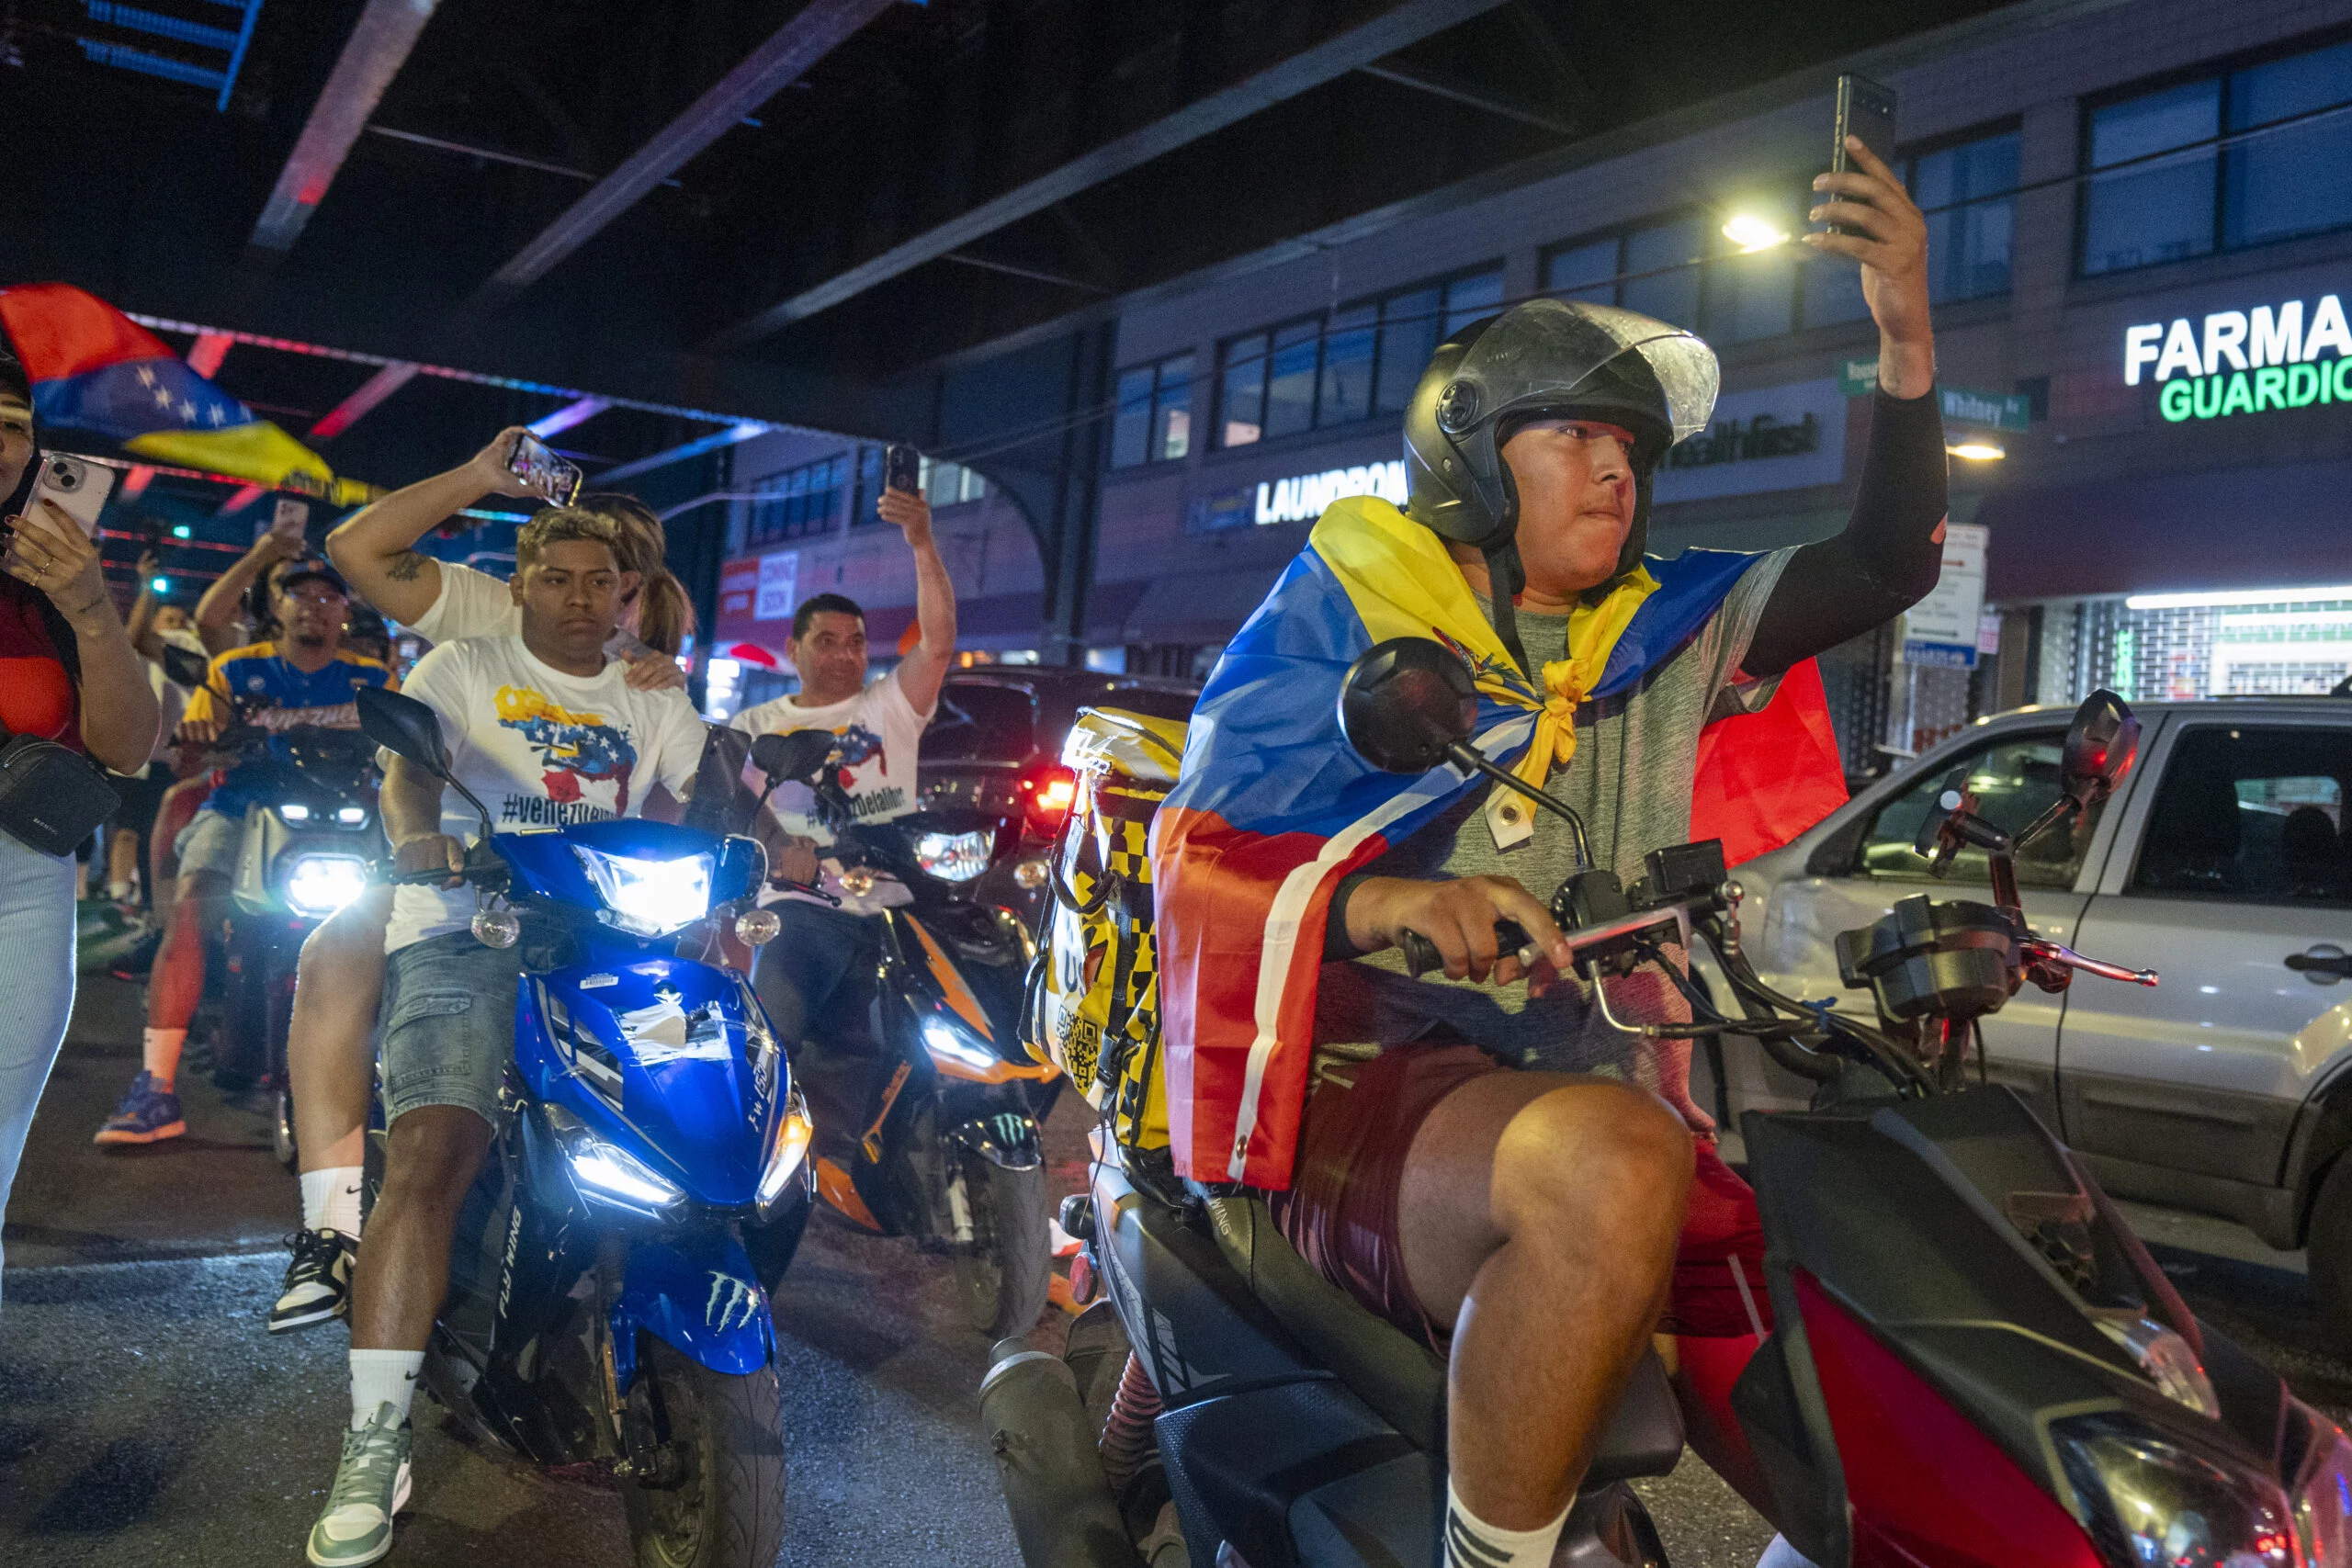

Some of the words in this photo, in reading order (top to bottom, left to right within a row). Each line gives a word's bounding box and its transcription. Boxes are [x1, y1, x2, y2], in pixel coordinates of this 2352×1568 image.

[2124, 294, 2352, 386] FARMA
[505, 1204, 522, 1268] WING
[1210, 1197, 1233, 1235] WING
